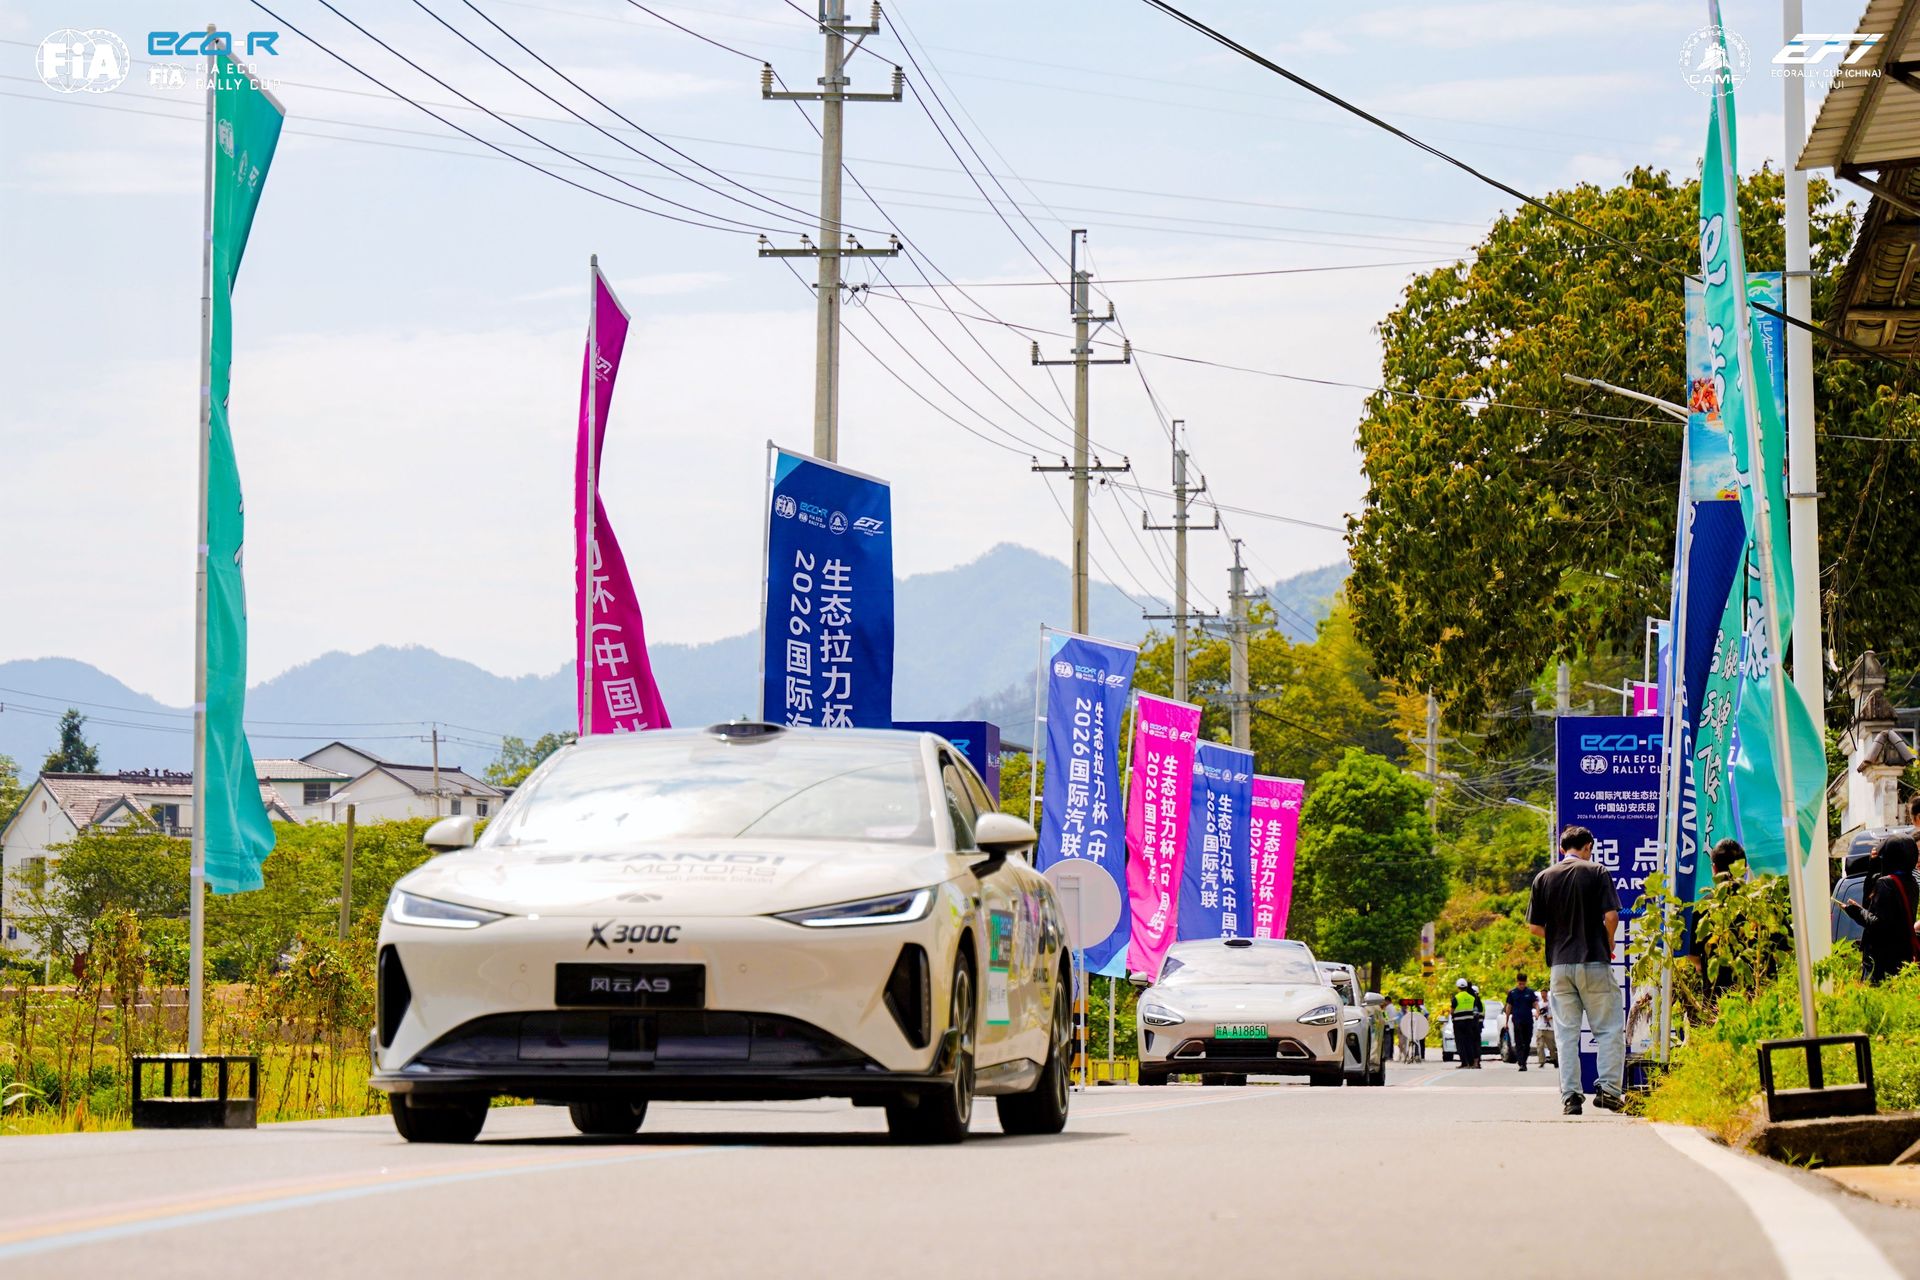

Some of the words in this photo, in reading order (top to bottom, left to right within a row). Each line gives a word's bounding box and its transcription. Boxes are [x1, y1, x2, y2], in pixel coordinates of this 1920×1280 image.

[819, 559, 854, 729] 生态拉力杯
[1581, 757, 1606, 772] FIA
[1612, 755, 1630, 763] FIA
[1633, 755, 1656, 763] ECO
[1612, 765, 1645, 774] RALLY
[1060, 698, 1091, 857] 2026国际汽联
[1573, 790, 1669, 800] 2026国际汽联生态拉
[1200, 789, 1219, 909] 2026国际汽联
[534, 853, 786, 865] SKANDI
[622, 864, 777, 876] MOTORS
[590, 977, 670, 993] 风云A9
